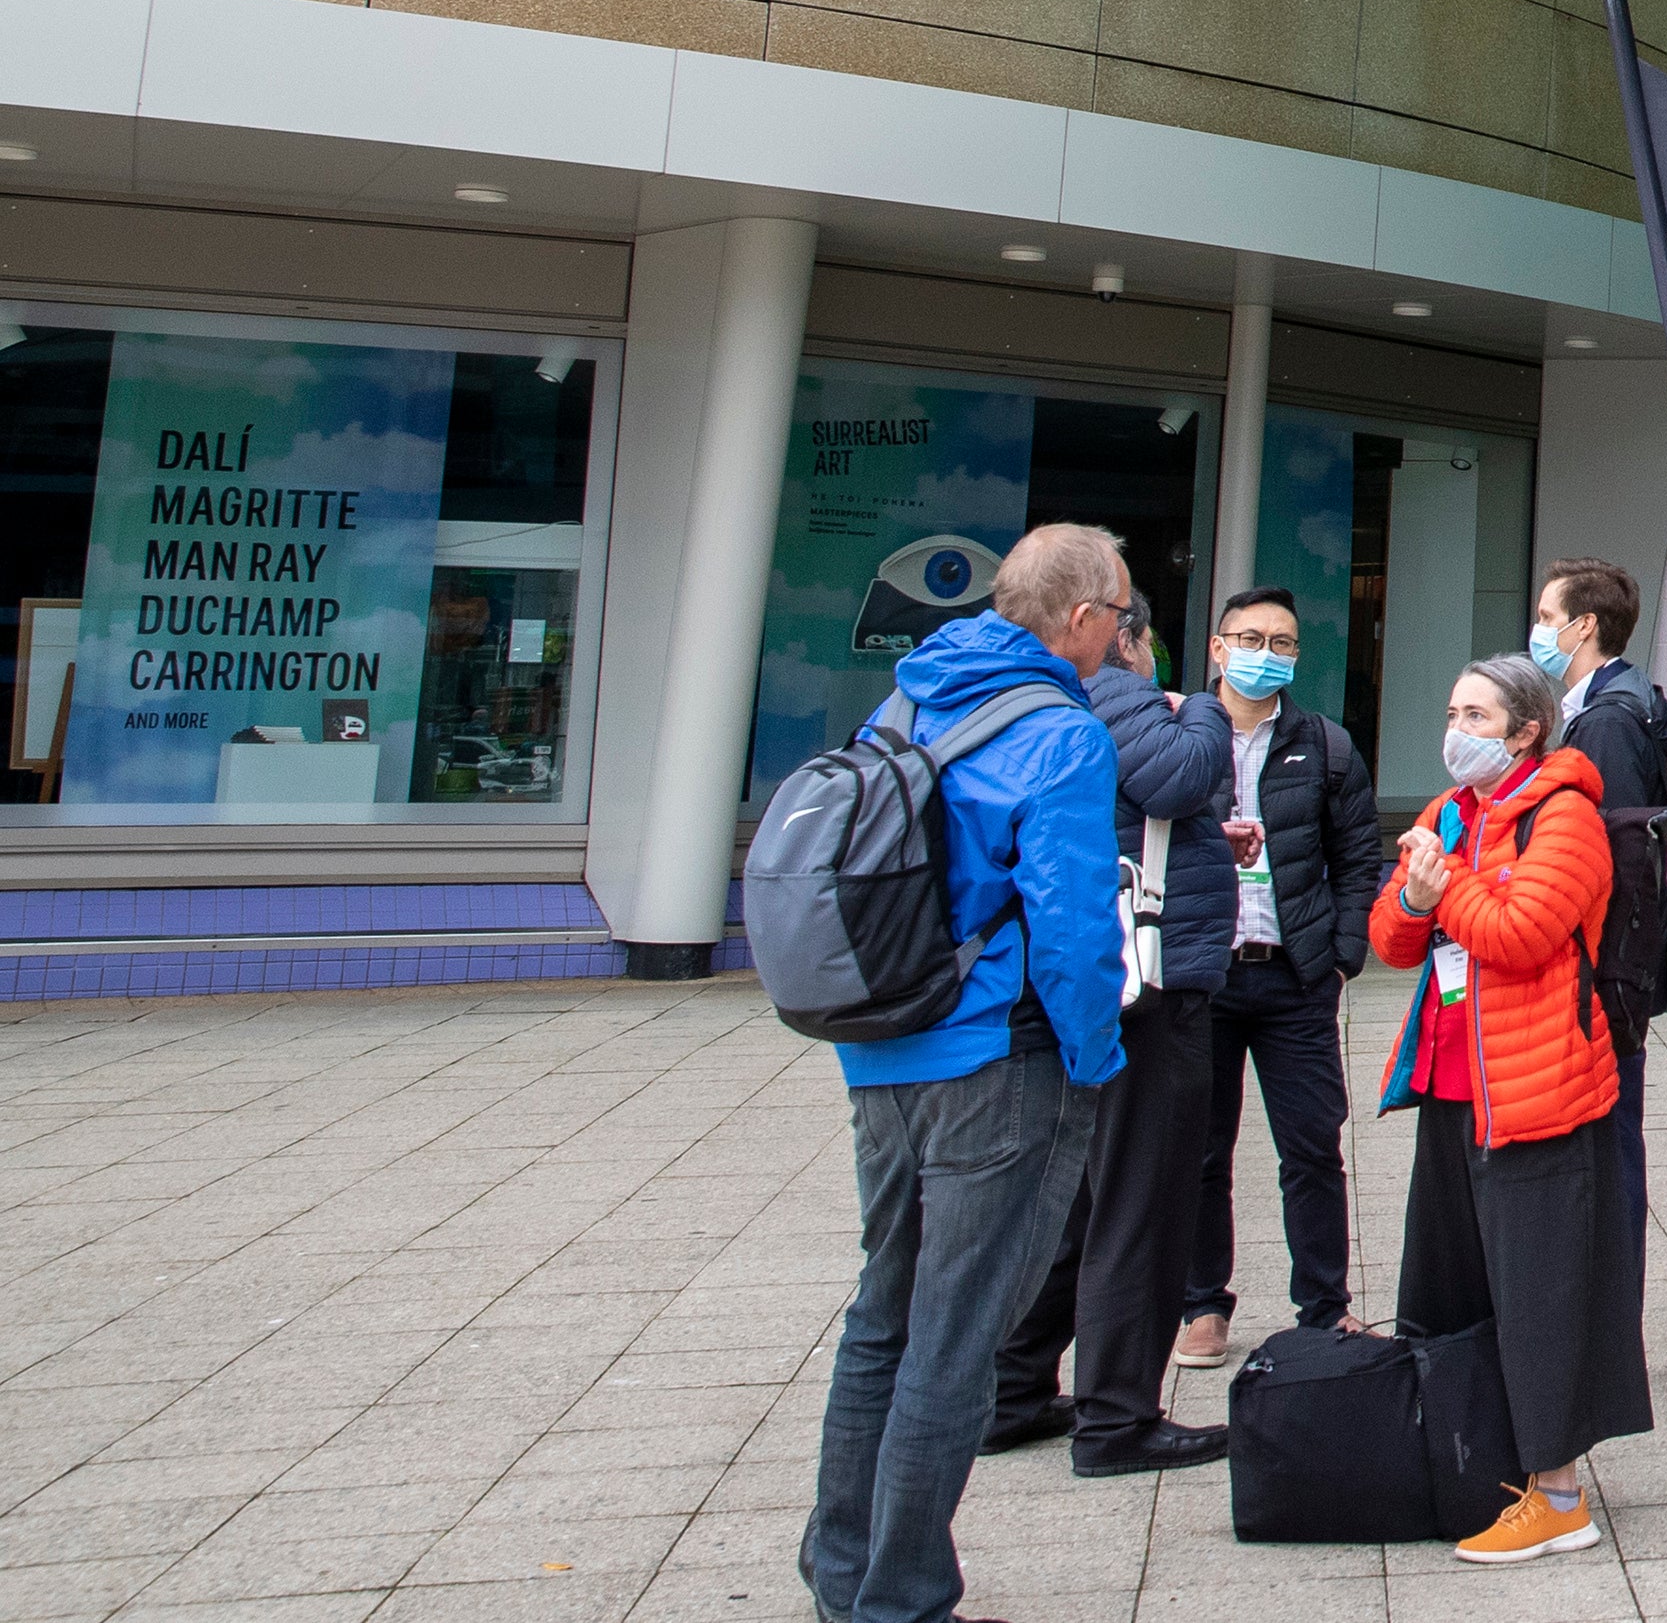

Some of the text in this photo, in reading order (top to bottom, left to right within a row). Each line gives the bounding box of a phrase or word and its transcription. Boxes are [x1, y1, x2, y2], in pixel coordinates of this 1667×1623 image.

[156, 423, 255, 473] DALÍ
[811, 418, 930, 447] SURREALIST
[813, 449, 854, 476] ART
[150, 483, 360, 530] MAGRITTE
[810, 507, 879, 520] MASTERPIECES
[142, 539, 328, 584] MAN RAY
[136, 594, 341, 638] DUCHAMP
[128, 649, 381, 692] CARRINGTON
[124, 712, 210, 730] AND MORE
